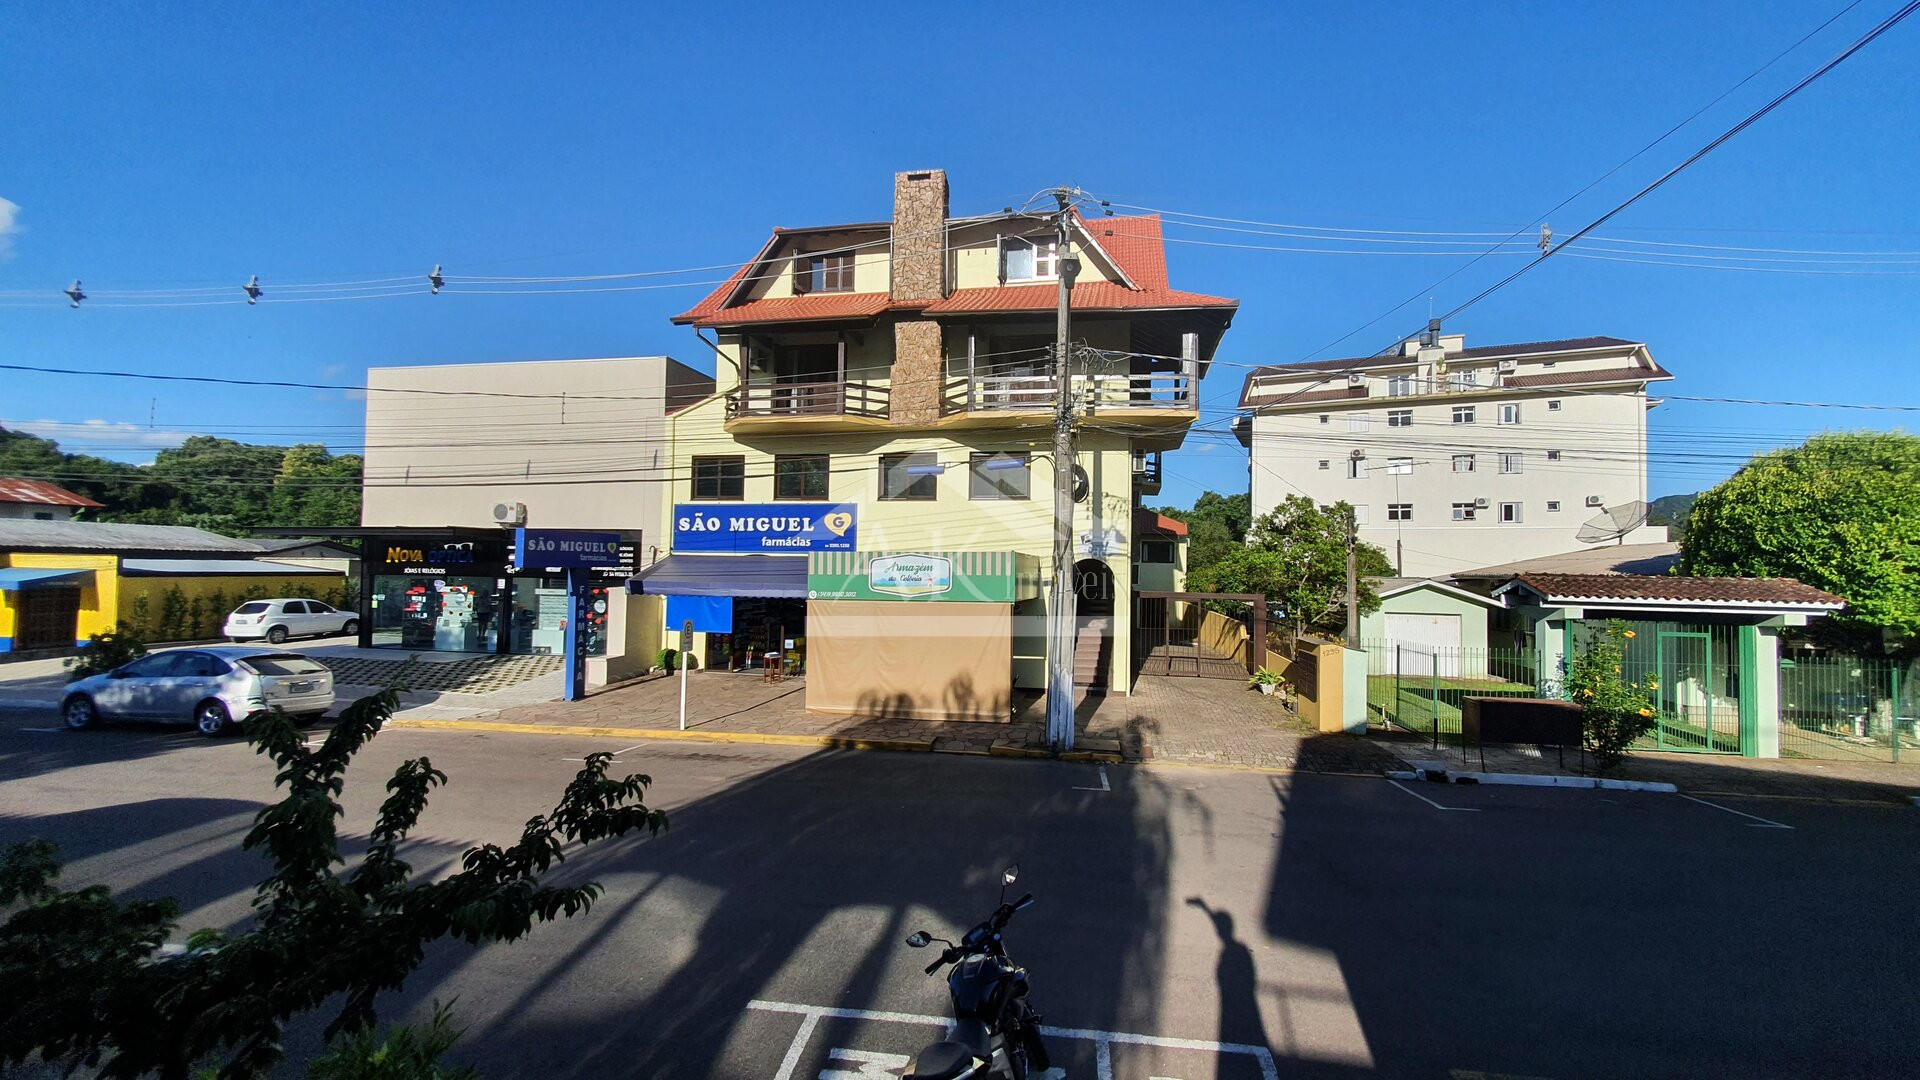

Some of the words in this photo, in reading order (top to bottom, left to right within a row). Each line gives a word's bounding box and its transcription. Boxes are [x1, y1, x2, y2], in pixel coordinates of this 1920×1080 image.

[678, 512, 721, 532] SÃO
[729, 517, 815, 532] MIGUEL
[527, 537, 556, 551] SÃO
[560, 541, 607, 553] MIGUEL
[761, 536, 811, 547] farmácias
[386, 546, 424, 563] NOVA
[884, 561, 934, 575] Armazém
